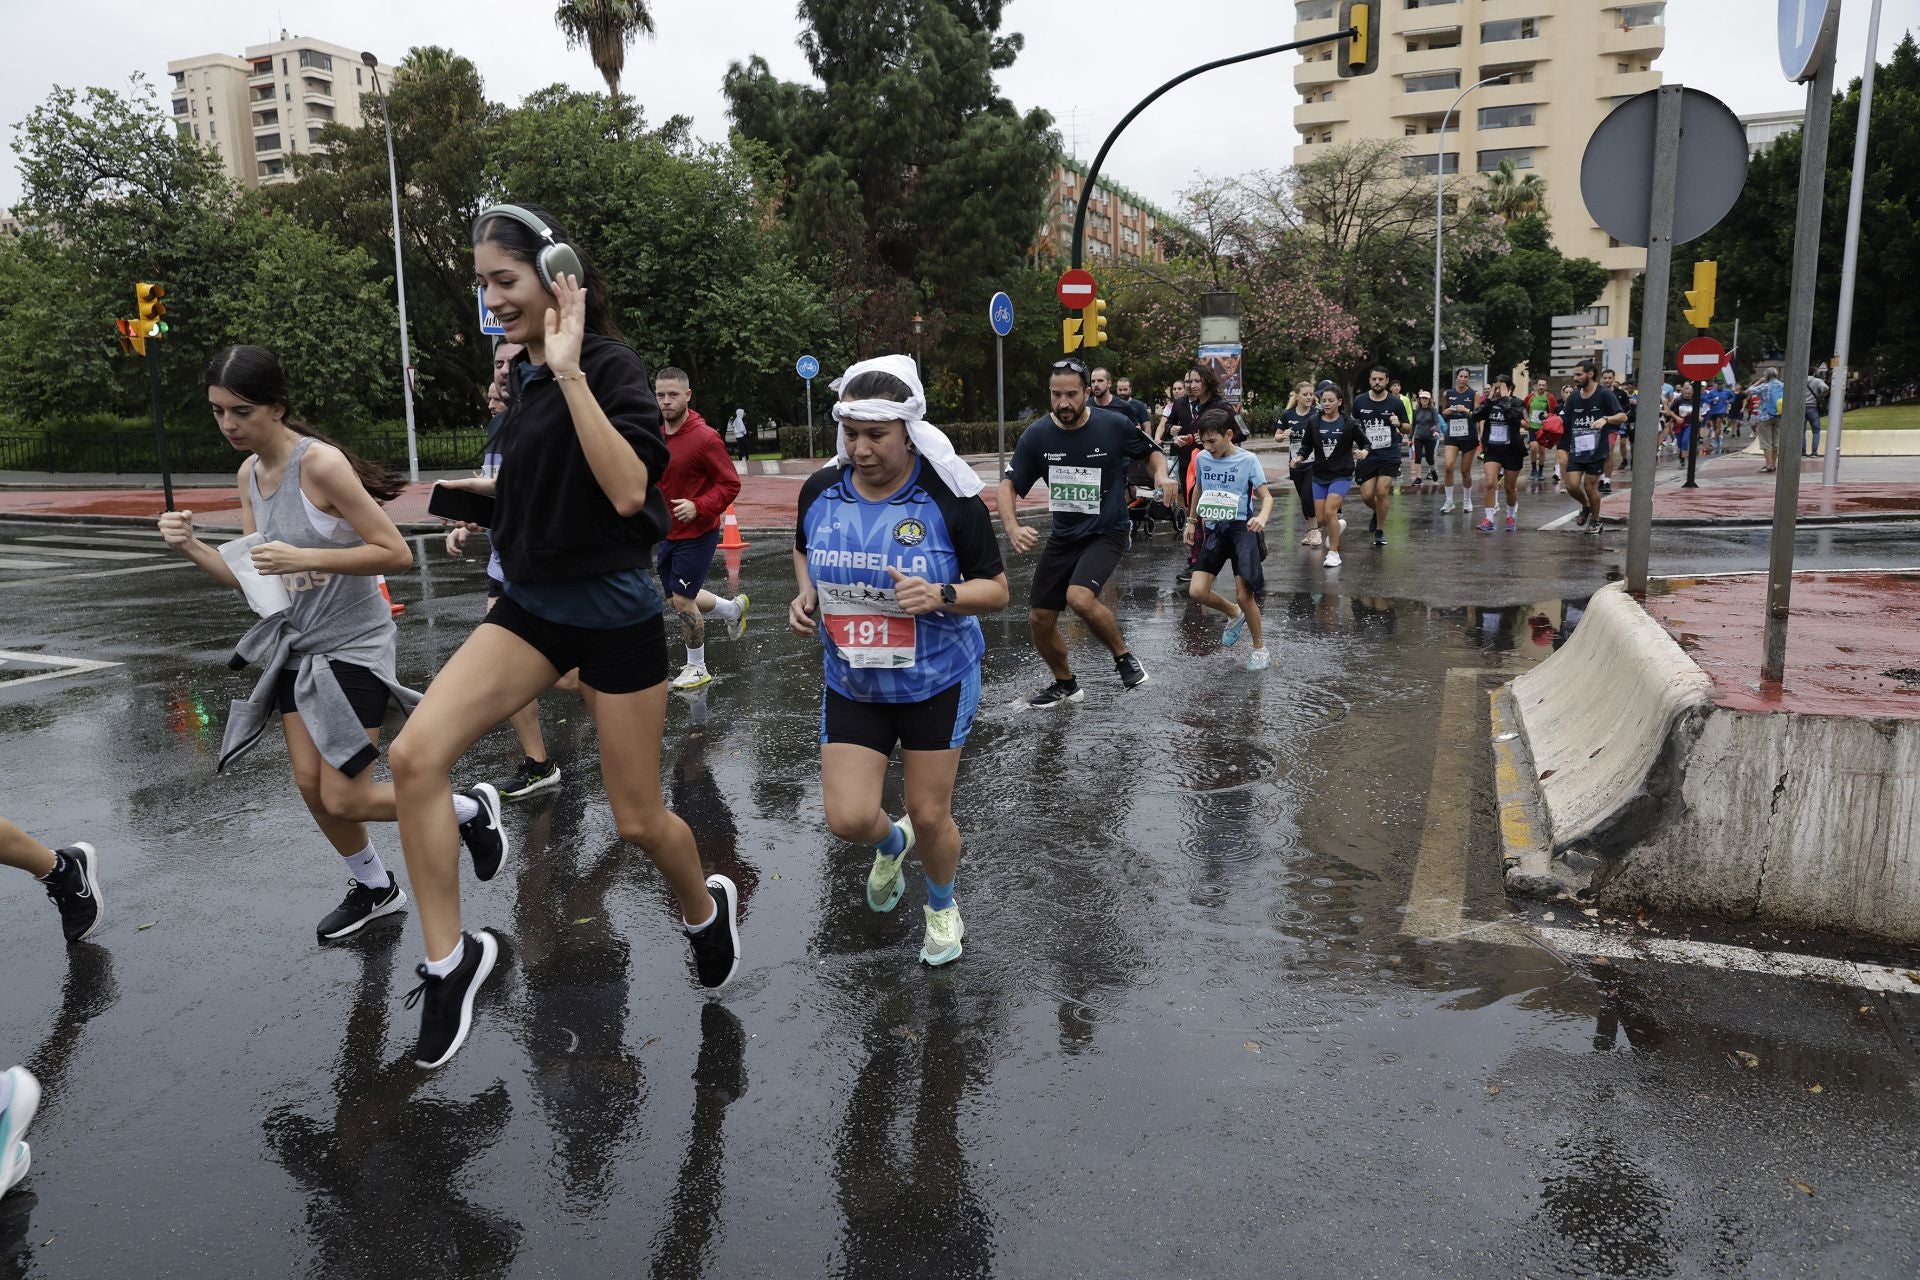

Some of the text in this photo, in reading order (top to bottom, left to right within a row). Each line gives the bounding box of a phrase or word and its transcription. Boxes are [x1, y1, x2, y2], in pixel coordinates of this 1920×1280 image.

[1203, 471, 1236, 484] nerja
[1053, 486, 1097, 501] 21104
[1199, 506, 1234, 521] 20906
[811, 549, 927, 573] MARBELLA
[843, 620, 889, 645] 191
